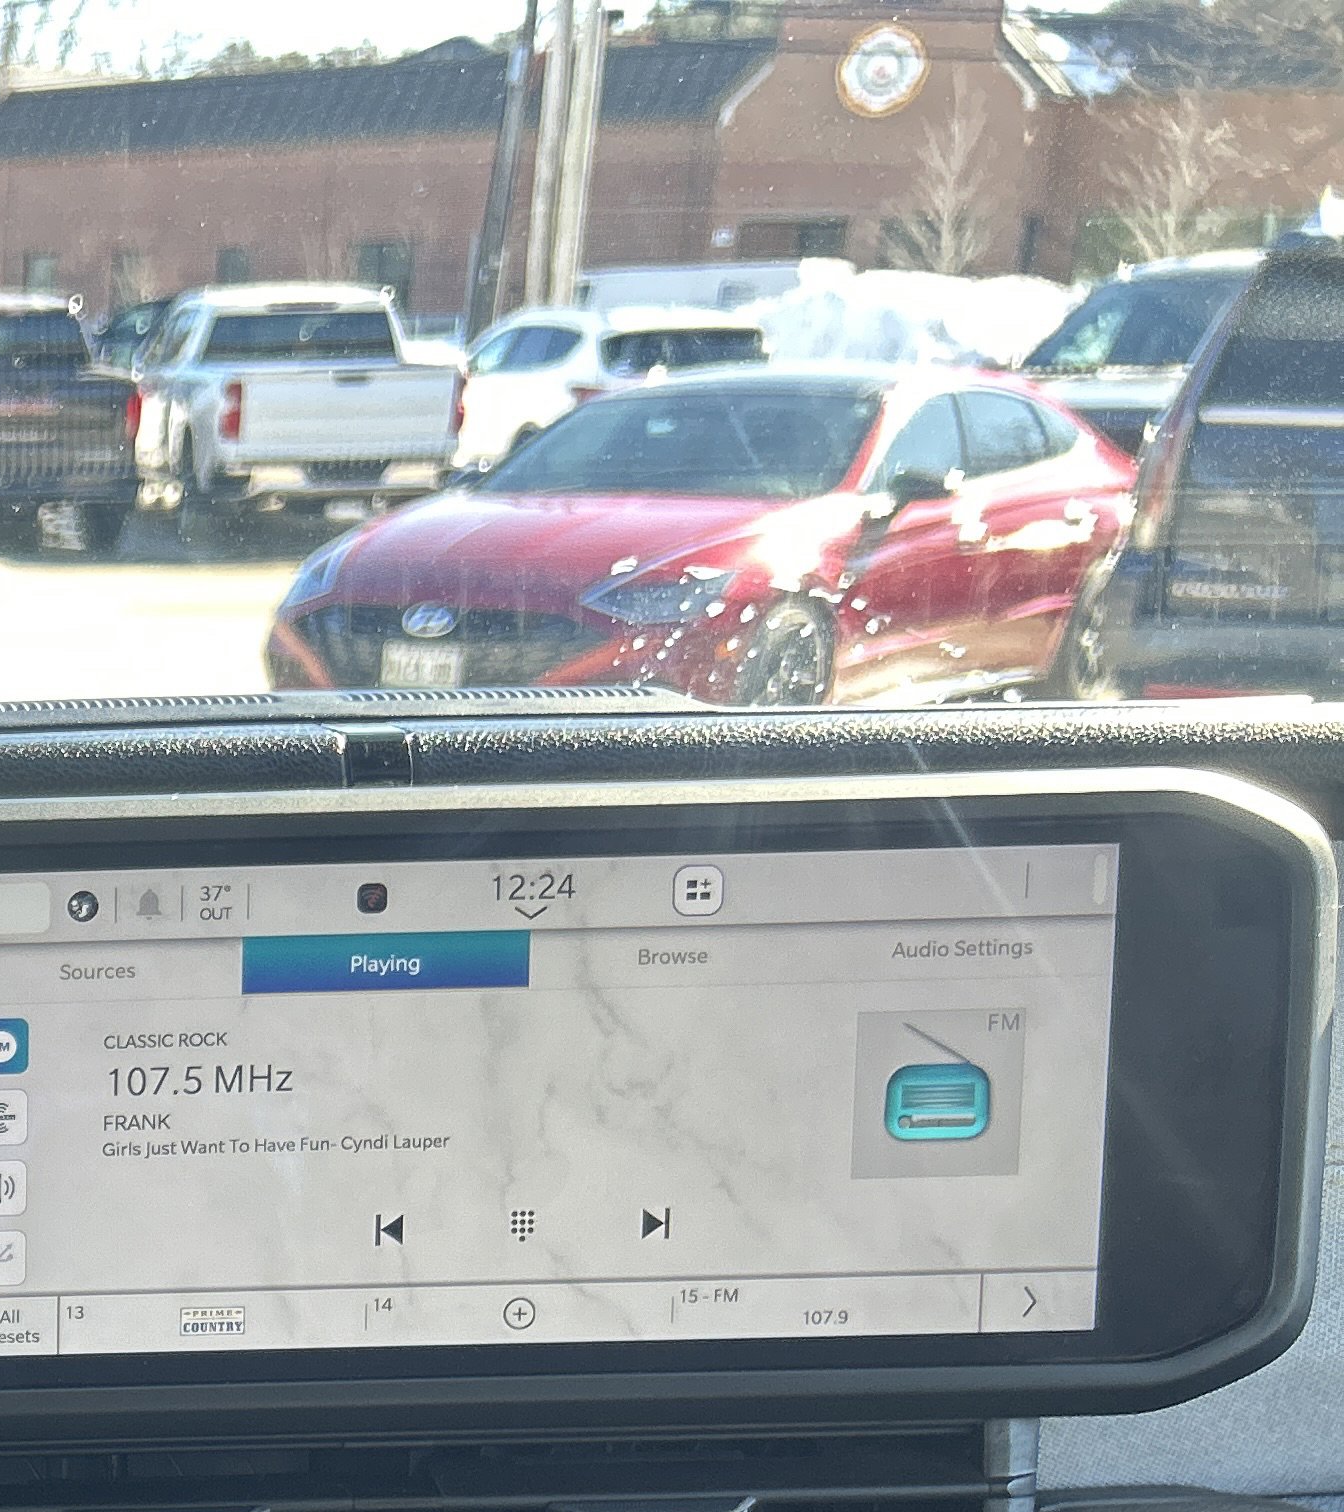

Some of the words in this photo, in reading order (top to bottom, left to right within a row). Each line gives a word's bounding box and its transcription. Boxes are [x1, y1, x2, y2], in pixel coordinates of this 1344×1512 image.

[492, 873, 576, 901] 12:24
[199, 907, 232, 921] OUT
[638, 947, 709, 966] Browse
[891, 939, 950, 959] Audio
[954, 937, 1034, 960] Settings
[59, 962, 136, 980] Sources
[350, 954, 421, 977] Playing
[987, 1013, 1021, 1032] FM
[103, 1034, 175, 1050] CLASSIC
[178, 1031, 228, 1048] ROCK
[108, 1065, 204, 1096] 107.5
[214, 1064, 294, 1094] MHz
[103, 1113, 172, 1132] FRANK
[101, 1141, 142, 1157] Girls
[145, 1140, 177, 1159] Just
[180, 1140, 226, 1155] Want
[229, 1139, 250, 1154] To
[254, 1138, 296, 1153] Have
[340, 1134, 389, 1154] Cyndi
[393, 1134, 451, 1152] Lauper
[374, 1297, 393, 1312] 14
[680, 1288, 699, 1303] 15
[713, 1288, 740, 1302] FM
[65, 1305, 85, 1320] 13
[192, 1309, 234, 1317] PRIME
[803, 1310, 850, 1326] 107.9
[183, 1321, 244, 1333] COUNTRY
